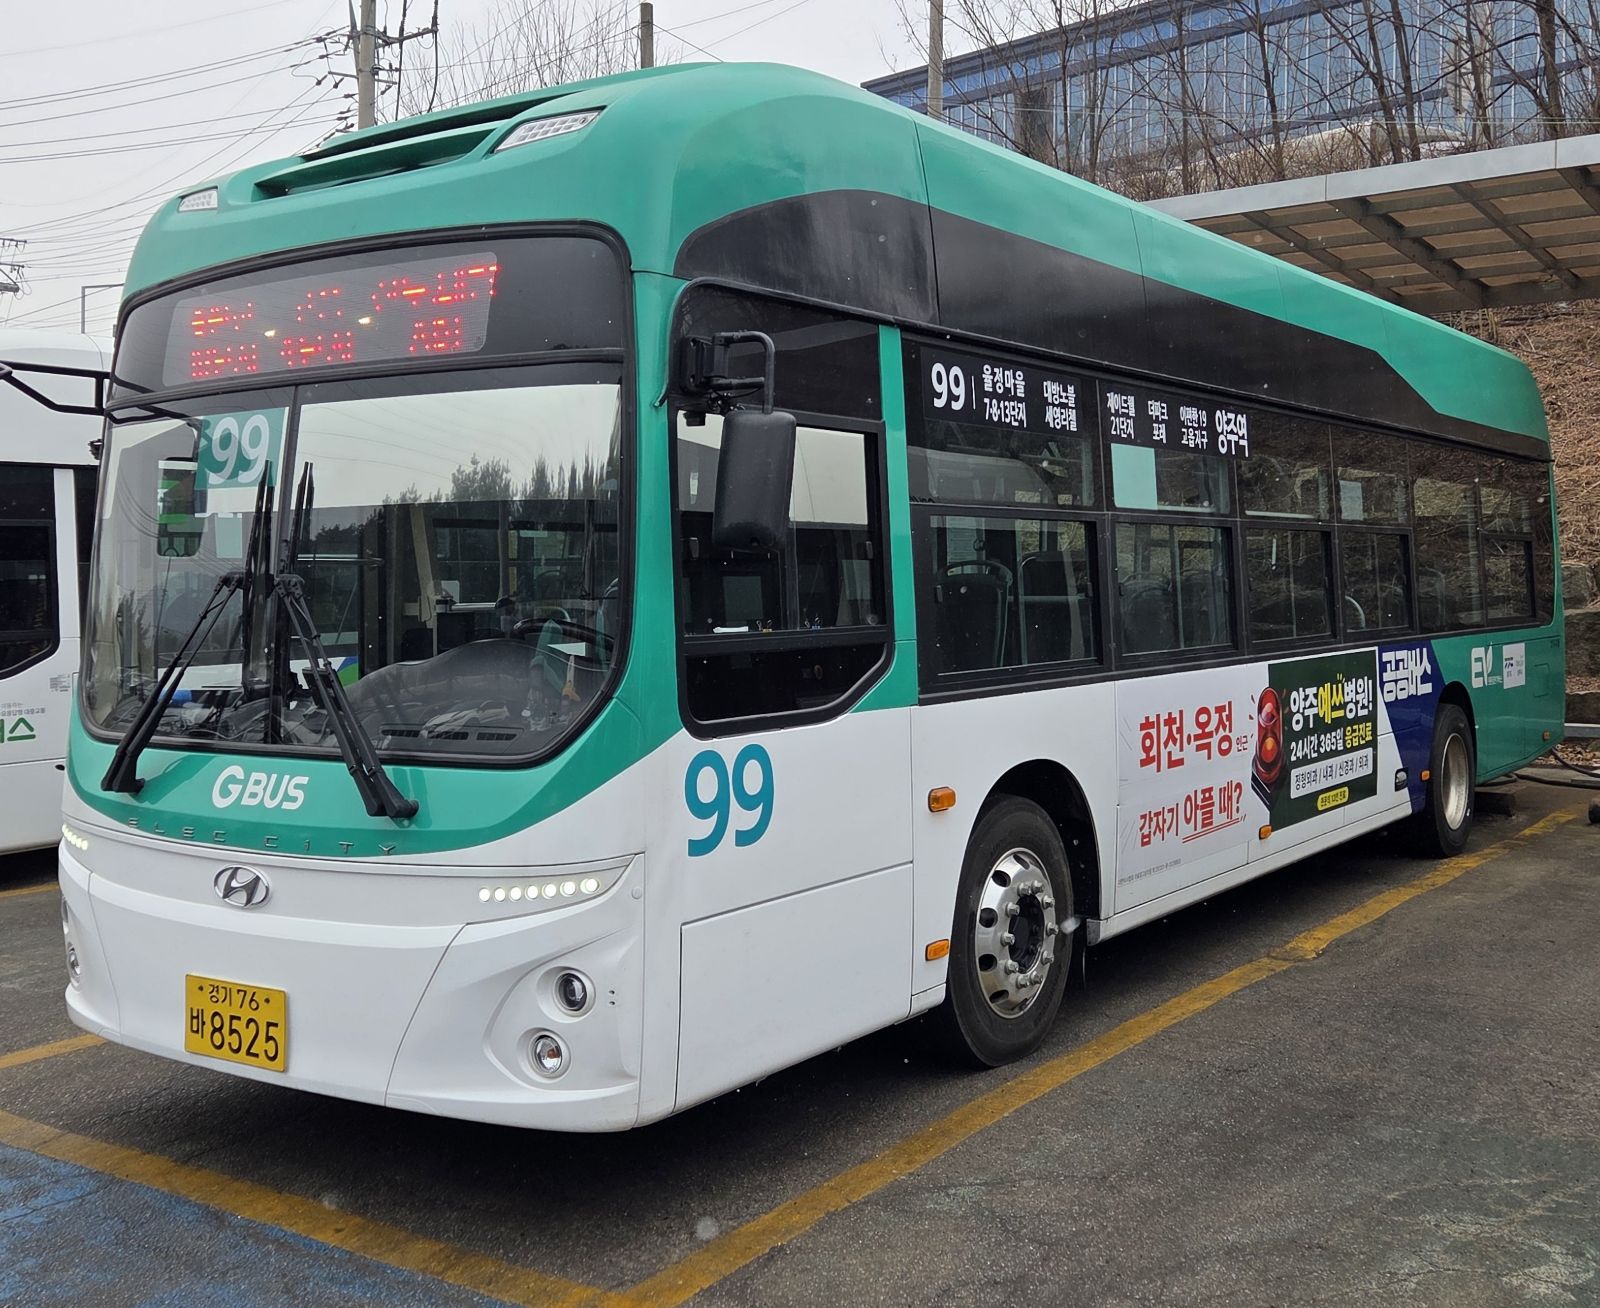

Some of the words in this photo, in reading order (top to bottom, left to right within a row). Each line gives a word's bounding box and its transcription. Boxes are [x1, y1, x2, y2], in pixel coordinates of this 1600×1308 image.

[931, 362, 965, 410] 99
[983, 364, 1025, 397] 율정마을
[1043, 380, 1076, 407] 대방노블
[1045, 406, 1077, 431] 세영리첼
[1111, 416, 1134, 439] 21단지
[1181, 428, 1208, 449] 고읍지구
[1215, 410, 1249, 457] 양주역
[209, 404, 269, 485] 99
[1382, 648, 1432, 702] 공공버스
[0, 717, 36, 743] 스
[1139, 701, 1233, 773] 회천·옥정
[1236, 735, 1248, 752] 인근
[1290, 733, 1318, 761] 24시간
[1320, 728, 1343, 753] 365일
[1345, 722, 1373, 748] 응급진료
[211, 765, 309, 809] GBUS
[684, 743, 774, 857] 99
[1139, 803, 1179, 847] 갑자기
[1183, 786, 1215, 831] 아플
[1218, 779, 1243, 820] 때?
[190, 1007, 279, 1062] 바8525
